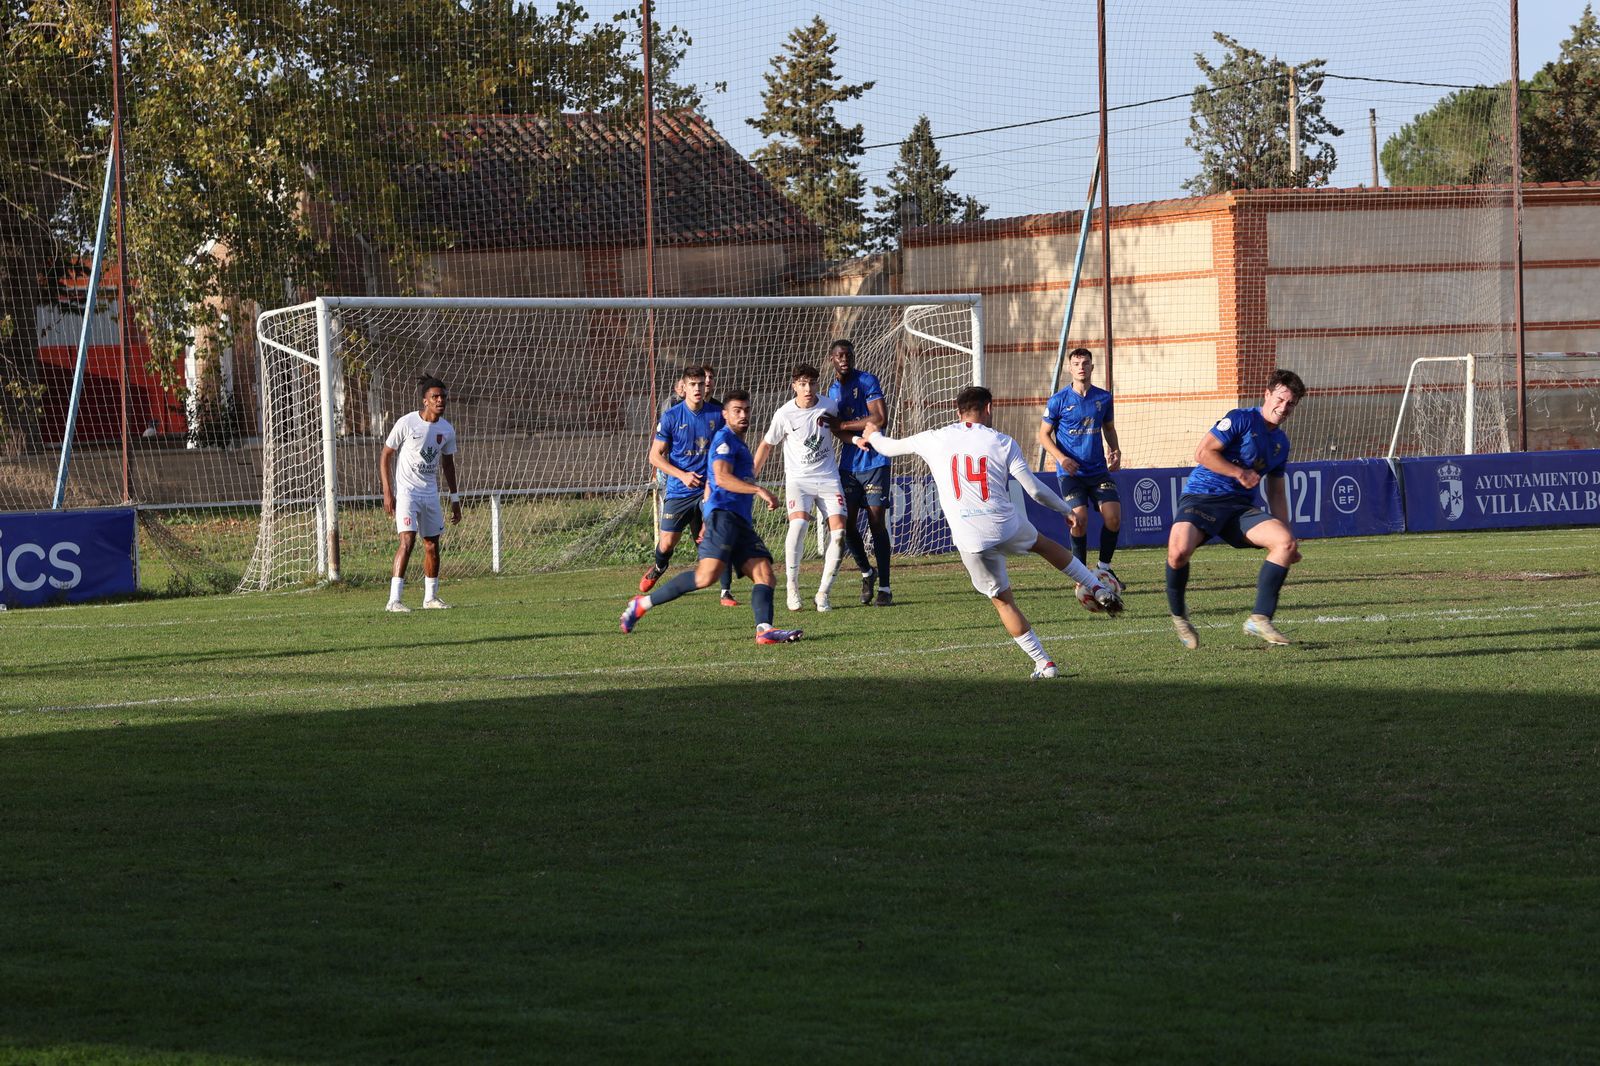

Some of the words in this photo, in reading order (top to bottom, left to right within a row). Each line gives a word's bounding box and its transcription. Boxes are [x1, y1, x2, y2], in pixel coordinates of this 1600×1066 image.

[950, 453, 991, 503] 14
[1475, 471, 1589, 490] AYUNTAMIENTO
[1338, 485, 1354, 494] RF
[1339, 496, 1355, 505] EF
[1475, 490, 1600, 515] VILLARALB
[1134, 515, 1162, 528] TERCERA
